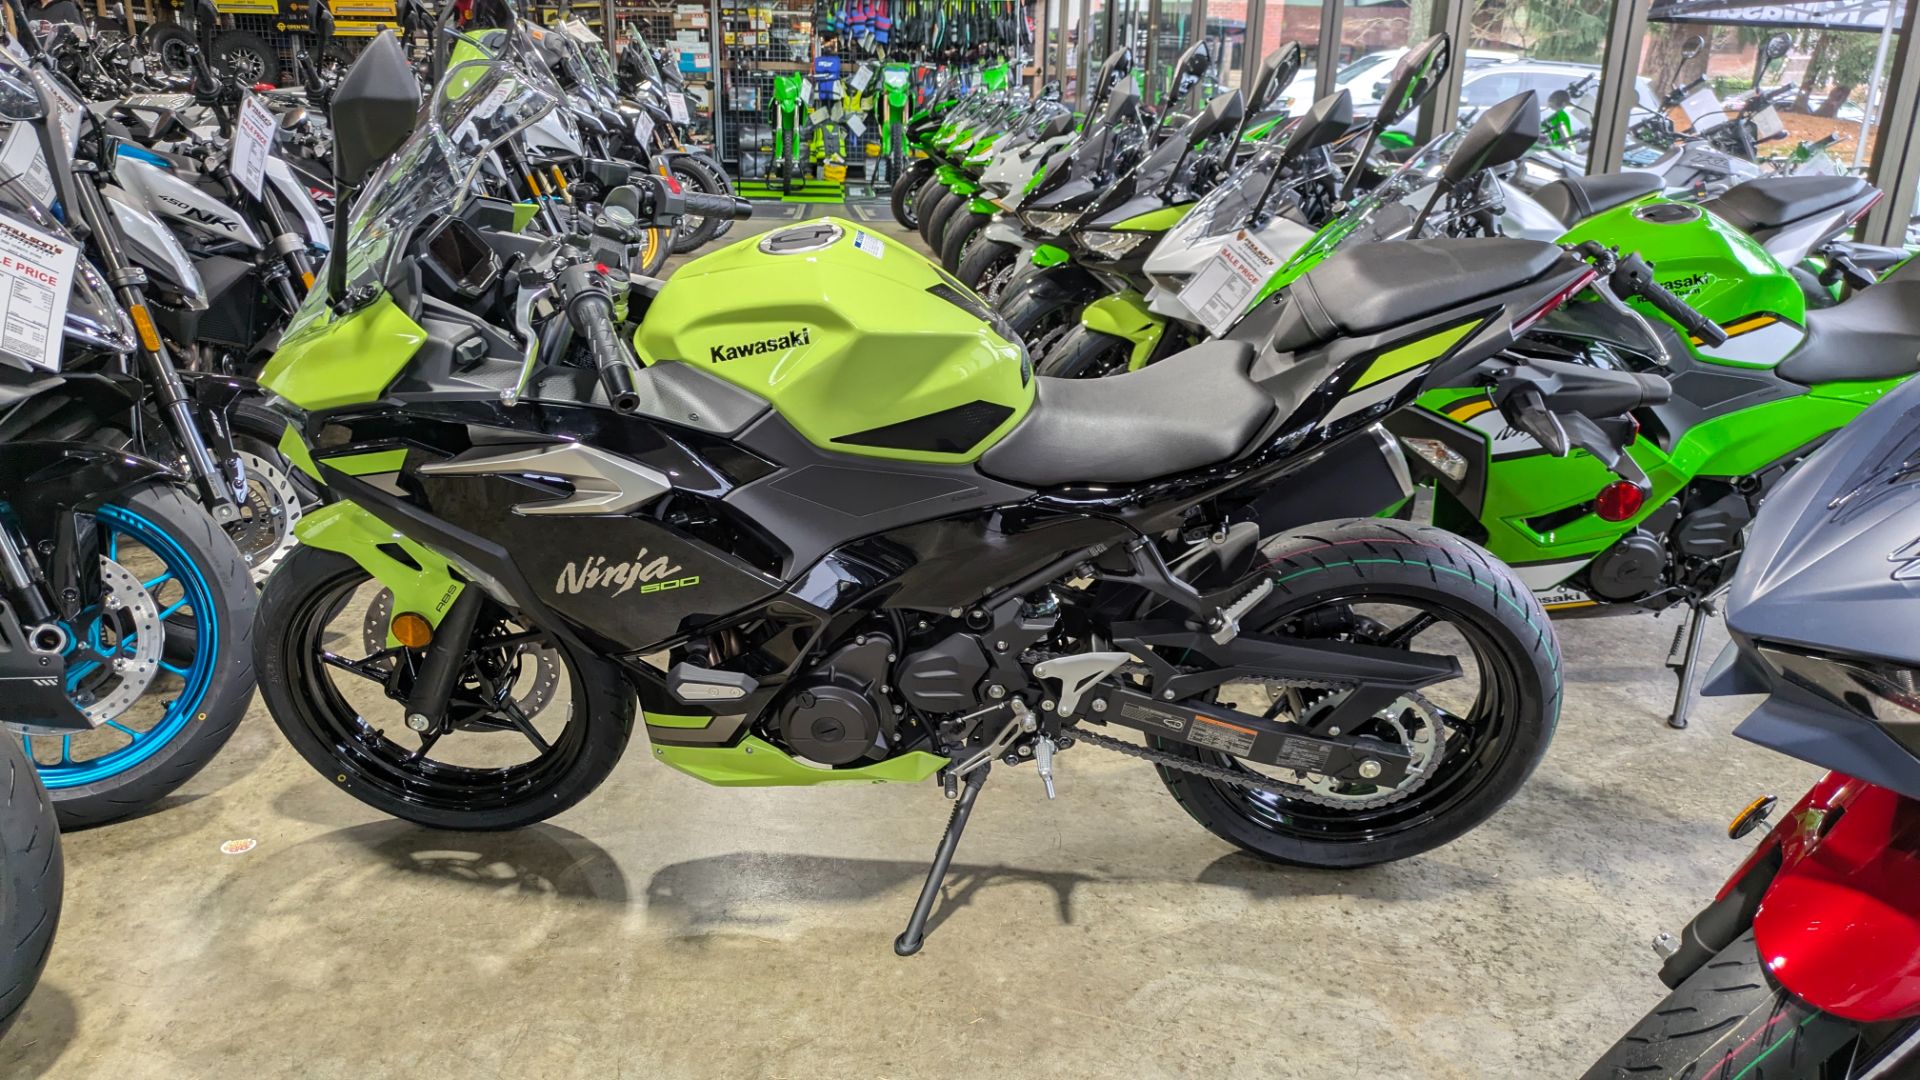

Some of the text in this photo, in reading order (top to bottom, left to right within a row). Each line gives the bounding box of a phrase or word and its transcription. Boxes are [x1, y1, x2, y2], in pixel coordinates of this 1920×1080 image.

[158, 194, 240, 232] 450 NK
[16, 262, 58, 287] PRICE
[1220, 248, 1239, 267] SALE
[1237, 264, 1260, 285] PRICE
[1660, 272, 1709, 291] asaki
[710, 327, 810, 363] Kawasaki
[555, 547, 683, 598] Ninja
[640, 575, 700, 594] 500
[435, 584, 457, 613] ABS
[1537, 592, 1581, 604] saki
